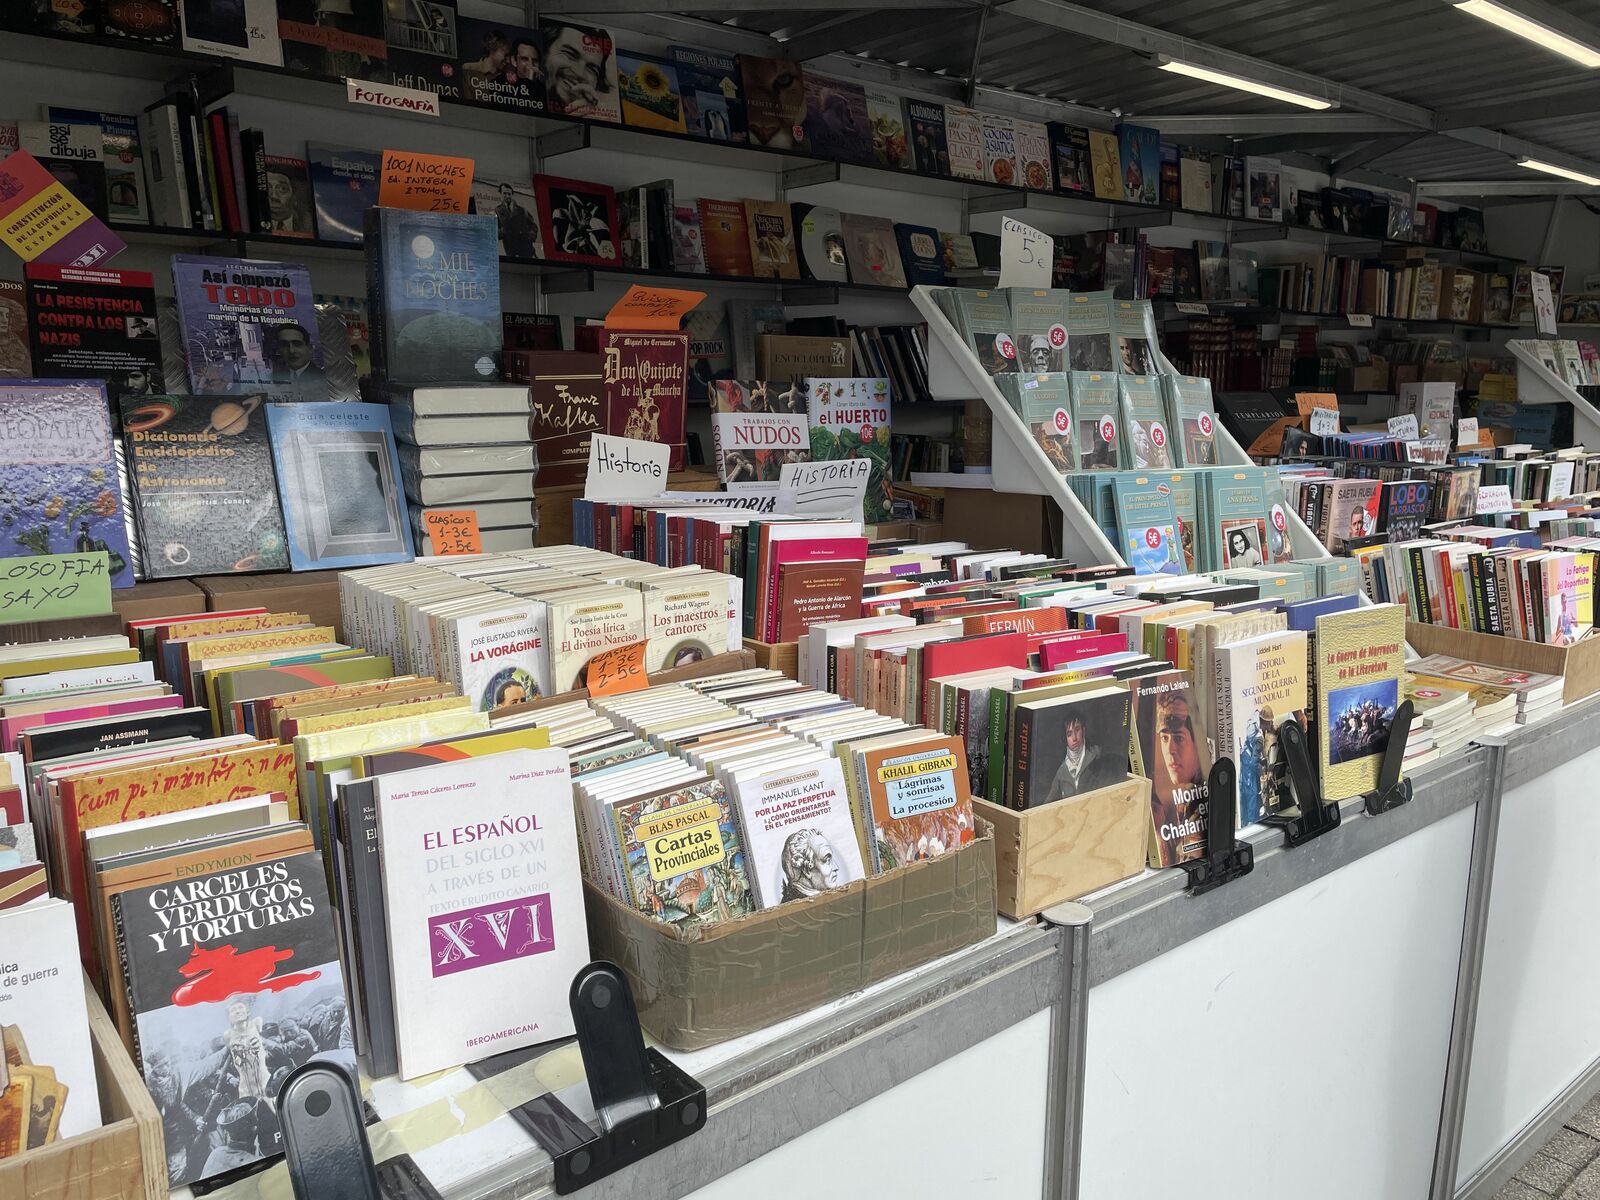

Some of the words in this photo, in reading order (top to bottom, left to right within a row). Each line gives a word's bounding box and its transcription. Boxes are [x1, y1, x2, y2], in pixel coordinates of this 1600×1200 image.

[471, 77, 518, 96] Celebrity
[520, 83, 531, 96] &
[475, 91, 545, 110] Performance
[49, 124, 71, 137] así
[983, 129, 1015, 141] COCINA
[50, 133, 69, 146] se
[50, 144, 97, 161] dibuja
[333, 157, 374, 173] España
[386, 156, 414, 174] 1001
[415, 161, 466, 179] NOCHES
[415, 187, 447, 197] TOMOS
[430, 198, 462, 213] 25€
[16, 233, 28, 244] DE
[26, 227, 37, 237] LA
[439, 251, 476, 272] MIL
[203, 269, 228, 285] Así
[231, 273, 291, 293] empezó
[201, 283, 297, 309] TODO
[405, 280, 489, 301] NOCHES
[35, 293, 54, 309] LA
[56, 294, 144, 313] RESISTENCIA
[219, 304, 260, 317] Memorias
[263, 307, 273, 317] de
[275, 309, 286, 318] un
[38, 312, 95, 330] CONTRA
[98, 314, 124, 330] LOS
[208, 312, 238, 325] marino
[240, 313, 249, 324] de
[251, 314, 259, 324] la
[40, 331, 81, 347] NAZIS
[624, 338, 642, 347] Miguel
[644, 338, 650, 346] de
[651, 338, 676, 346] Cervantes
[1053, 331, 1066, 343] 5€
[704, 341, 725, 354] ROCK
[604, 347, 636, 384] Don
[640, 359, 683, 384] Quijote
[554, 384, 600, 406] Franz
[621, 384, 631, 397] de
[632, 384, 641, 397] la
[652, 383, 681, 398] Mancha
[330, 412, 370, 421] celeste
[534, 403, 600, 435] Kafka
[743, 418, 775, 426] TRABAJOS
[819, 411, 833, 425] el
[835, 410, 888, 425] HUERTO
[1055, 414, 1067, 428] 5€
[1202, 418, 1211, 430] 5€
[133, 430, 218, 443] Diccionario
[733, 425, 801, 446] NUDOS
[860, 426, 874, 440] 10€
[1103, 423, 1113, 438] 5€
[1153, 430, 1163, 443] 5€
[135, 446, 236, 458] Enciclopédico
[712, 424, 725, 473] NUDOS
[596, 438, 662, 477] Historia
[137, 461, 158, 472] de
[790, 462, 869, 488] HISTORIA
[1337, 489, 1358, 501] SAETA
[1359, 487, 1377, 498] RUBIA
[1390, 484, 1428, 506] LOBO
[1306, 503, 1314, 526] RUBIA
[1321, 503, 1329, 528] RUBIA
[1390, 504, 1425, 516] CARRASCO
[1147, 531, 1160, 545] 5€
[664, 602, 687, 612] Richard
[688, 600, 710, 610] Wagner
[793, 598, 808, 606] Pedro
[808, 596, 826, 605] Antonio
[834, 595, 852, 603] Alarcón
[808, 604, 824, 612] Guerra
[653, 614, 672, 627] Los
[674, 609, 718, 624] maestros
[471, 636, 486, 648] JOSÉ
[487, 630, 516, 644] EUSTASIO
[517, 626, 539, 637] RIVERA
[574, 624, 601, 638] Poesía
[603, 622, 625, 634] lírica
[665, 622, 707, 637] cantores
[471, 651, 486, 663] LA
[487, 638, 542, 658] VORÁGINE
[561, 641, 571, 652] El
[573, 639, 602, 651] divino
[605, 632, 638, 646] Narciso
[1368, 643, 1399, 658] Marruecos
[1256, 656, 1286, 672] HISTORIA
[1262, 672, 1270, 681] DE
[1271, 669, 1281, 679] LA
[1137, 684, 1169, 697] Fernando
[1170, 680, 1190, 692] Lalana
[1241, 682, 1270, 698] SEGUNDA
[1271, 675, 1299, 691] GUERRA
[1254, 692, 1283, 706] MUNDIAL
[100, 734, 114, 742] JAN
[115, 728, 149, 741] ASSMANN
[1019, 722, 1029, 757] audaz
[883, 765, 917, 780] KHALIL
[918, 757, 953, 773] GIBRAN
[1018, 759, 1027, 771] El
[509, 772, 530, 782] Marina
[546, 766, 565, 776] Peralta
[411, 788, 430, 798] Teresa
[453, 781, 477, 792] Lorenzo
[898, 775, 943, 791] Lágrimas
[761, 787, 802, 806] IMMANUEL
[802, 780, 825, 794] KANT
[897, 792, 905, 801] y
[906, 784, 946, 798] sonrisas
[1017, 781, 1025, 808] Galdós
[755, 807, 771, 819] POR
[771, 804, 782, 814] LA
[782, 800, 797, 812] PAZ
[798, 789, 837, 806] PERPETUA
[791, 800, 831, 817] ORIENTARSE
[893, 805, 905, 816] La
[907, 796, 955, 814] procesión
[649, 820, 675, 836] BLAS
[675, 810, 711, 828] PASCAL
[765, 823, 775, 832] EN
[775, 820, 784, 830] EL
[784, 806, 833, 826] PENSAMIENTO?
[423, 831, 448, 851] EL
[452, 814, 544, 846] ESPAÑOL
[655, 829, 713, 855] Cartas
[426, 854, 460, 874] DEL
[463, 843, 515, 868] SIGLO
[519, 838, 546, 858] XVI
[654, 842, 720, 874] Provinciales
[175, 853, 253, 878] ENDYMION
[442, 868, 495, 892] TRAVÉS
[500, 863, 521, 882] DE
[527, 860, 548, 877] UN
[149, 861, 289, 911] CARCELES
[154, 878, 304, 931] VERDUGOS
[429, 899, 461, 914] TEXTO
[461, 889, 506, 908] ERUDITO
[148, 930, 171, 953] Y
[172, 896, 316, 948] TORTURAS
[434, 900, 552, 968] XVI
[3, 975, 18, 988] de
[21, 965, 59, 987] guerra
[466, 1022, 540, 1048] IBEROAMERICANA
